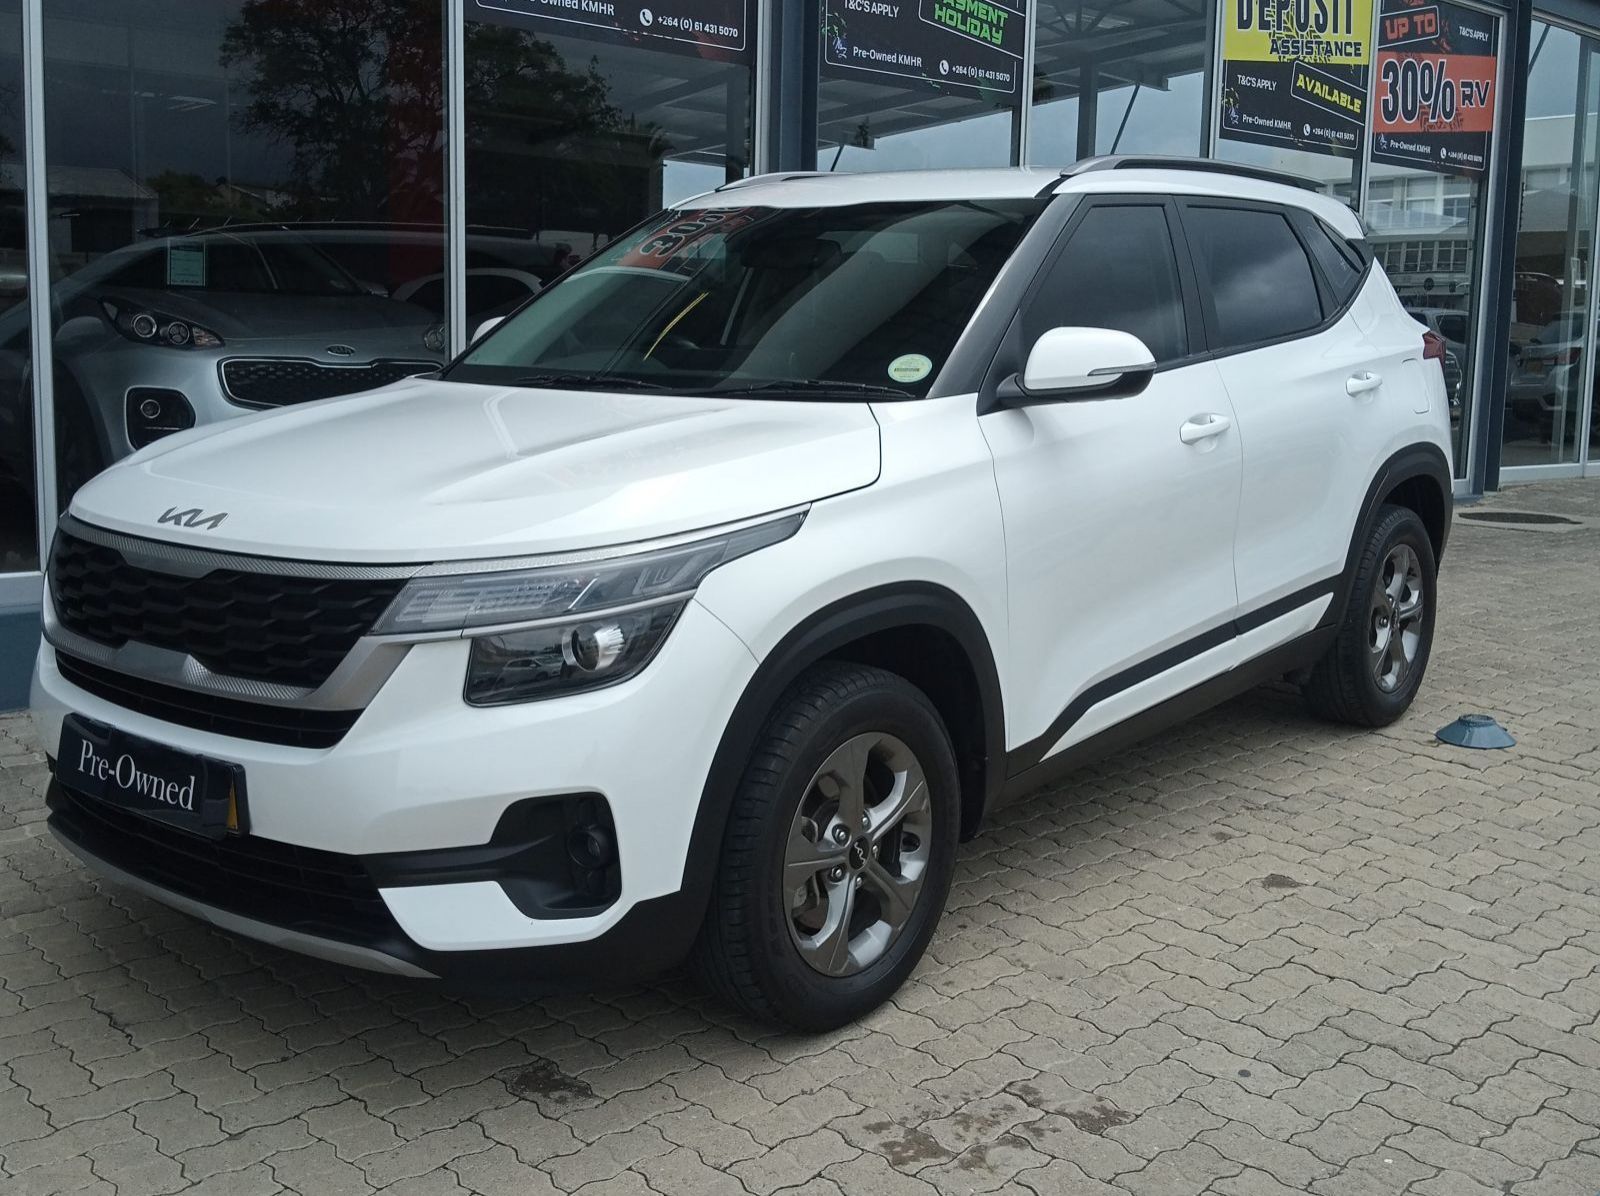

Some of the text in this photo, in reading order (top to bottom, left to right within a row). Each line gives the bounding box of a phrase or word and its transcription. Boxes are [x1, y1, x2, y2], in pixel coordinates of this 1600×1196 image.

[581, 0, 615, 16] KMHR
[872, 2, 899, 18] APPLY
[658, 16, 738, 37] +264 (0) 61 431 5070
[934, 3, 1003, 45] HOLIDAY
[1385, 13, 1436, 40] UP TO
[1473, 30, 1489, 42] APPLY
[853, 46, 922, 67] Pre-Owned KMHR
[1269, 39, 1362, 57] ASSISTANCE
[968, 66, 977, 78] (0)
[996, 72, 1010, 82] 5070
[1237, 74, 1277, 91] T&C'S APPLY
[1296, 73, 1361, 113] AVAILABLE
[1381, 58, 1492, 124] 30% RV
[1242, 114, 1291, 130] Pre-Owned KMHR
[1390, 139, 1416, 152] Pre-Owned
[157, 506, 229, 530] KIA
[78, 739, 196, 811] Pre-Owned
